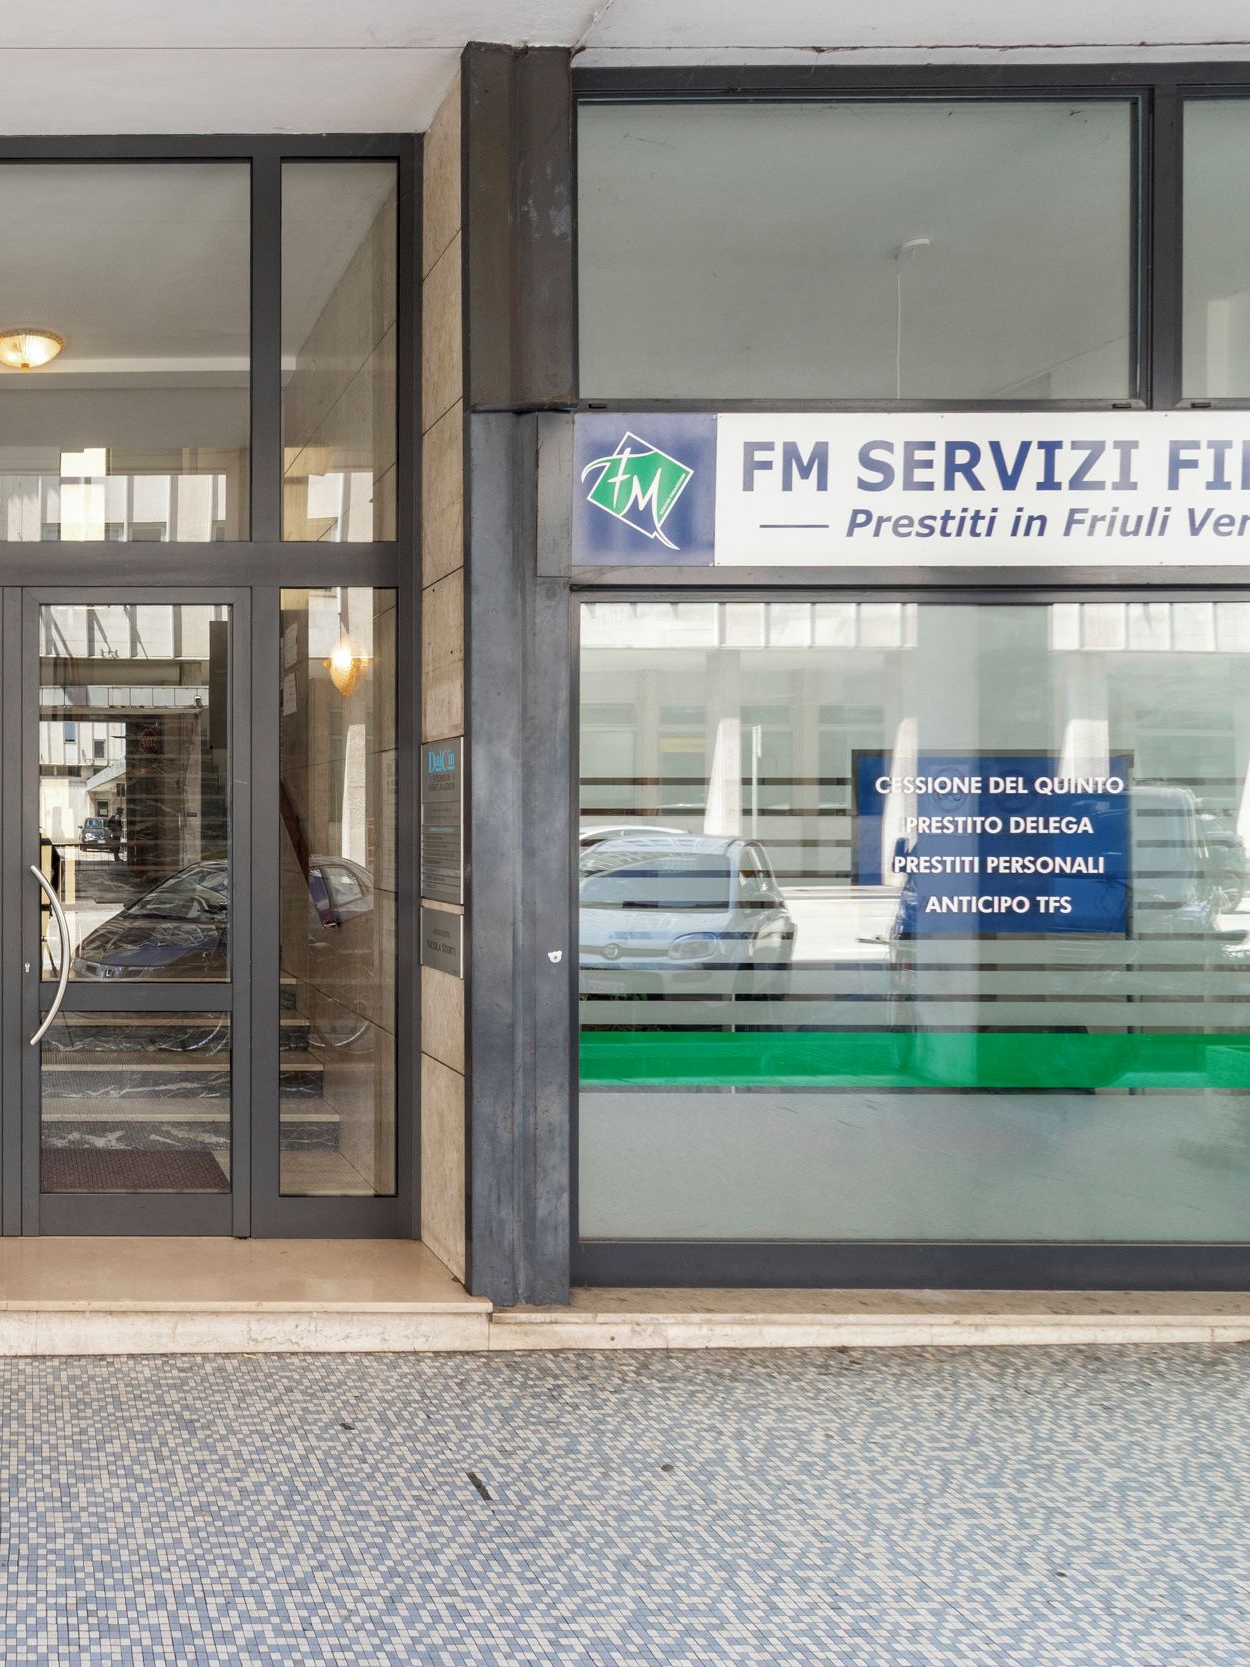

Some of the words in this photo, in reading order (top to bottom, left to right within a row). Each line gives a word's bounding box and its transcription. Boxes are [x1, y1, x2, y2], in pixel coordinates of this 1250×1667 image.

[742, 441, 829, 492] FM
[857, 440, 1139, 492] SERVIZI
[1168, 439, 1250, 491] FI
[846, 507, 997, 538] Prestiti
[1010, 507, 1048, 538] in
[1063, 506, 1172, 537] Friuli
[875, 776, 982, 794] CESSIONE
[989, 776, 1028, 794] DEL
[1034, 776, 1124, 796] QUINTO
[906, 816, 1003, 834] PRESTITO
[1010, 816, 1094, 834] DELEGA
[894, 856, 979, 874] PRESTITI
[986, 856, 1105, 874] PERSONALI
[925, 895, 1030, 914] ANTICIPO
[1036, 895, 1072, 914] TFS
